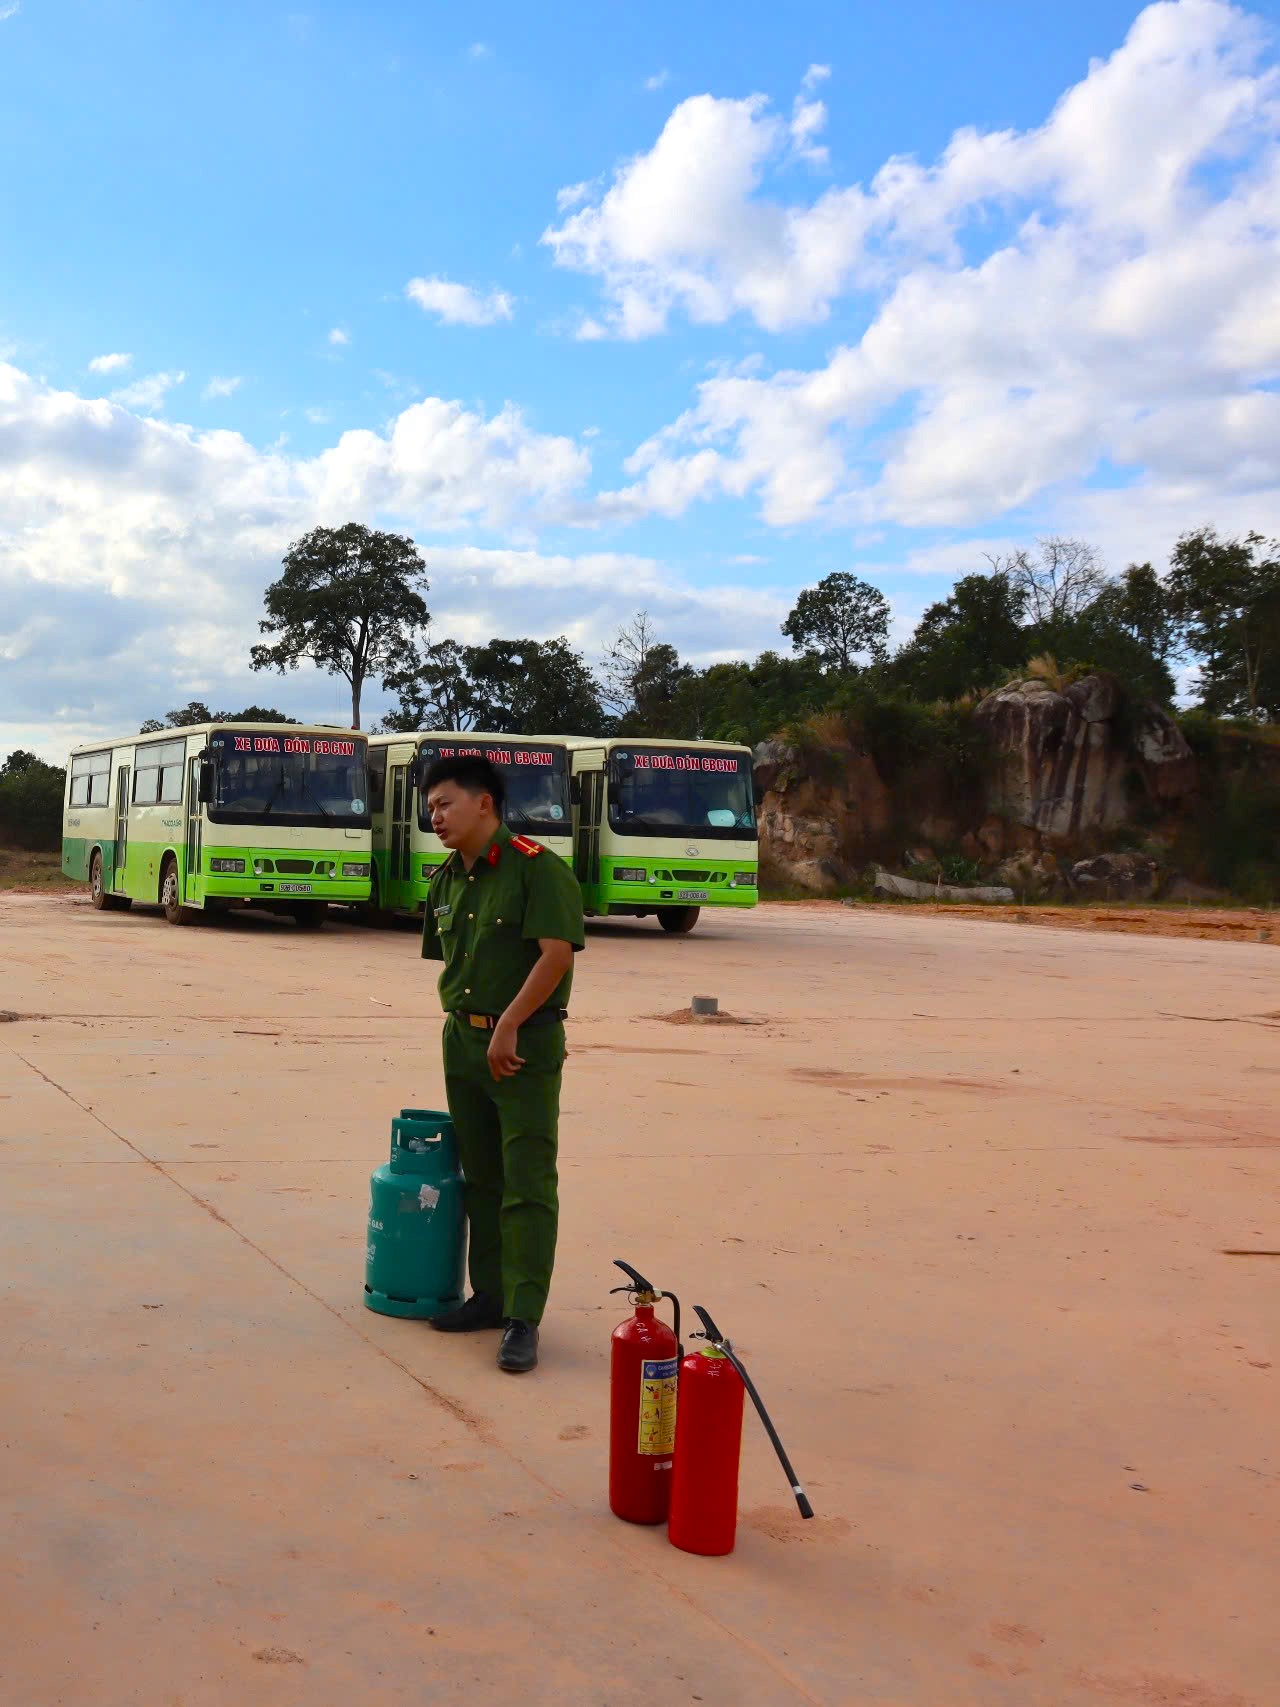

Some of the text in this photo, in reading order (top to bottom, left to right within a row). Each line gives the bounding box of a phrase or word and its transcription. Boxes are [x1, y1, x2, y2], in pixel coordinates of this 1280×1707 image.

[234, 737, 251, 751] XE
[254, 737, 280, 752] ĐƯA
[284, 737, 310, 753] ĐÓN
[439, 748, 454, 759] XE
[634, 755, 738, 772] XE ĐƯA ĐÓN CBCNV
[553, 806, 560, 817] 3
[371, 1219, 384, 1231] GAS
